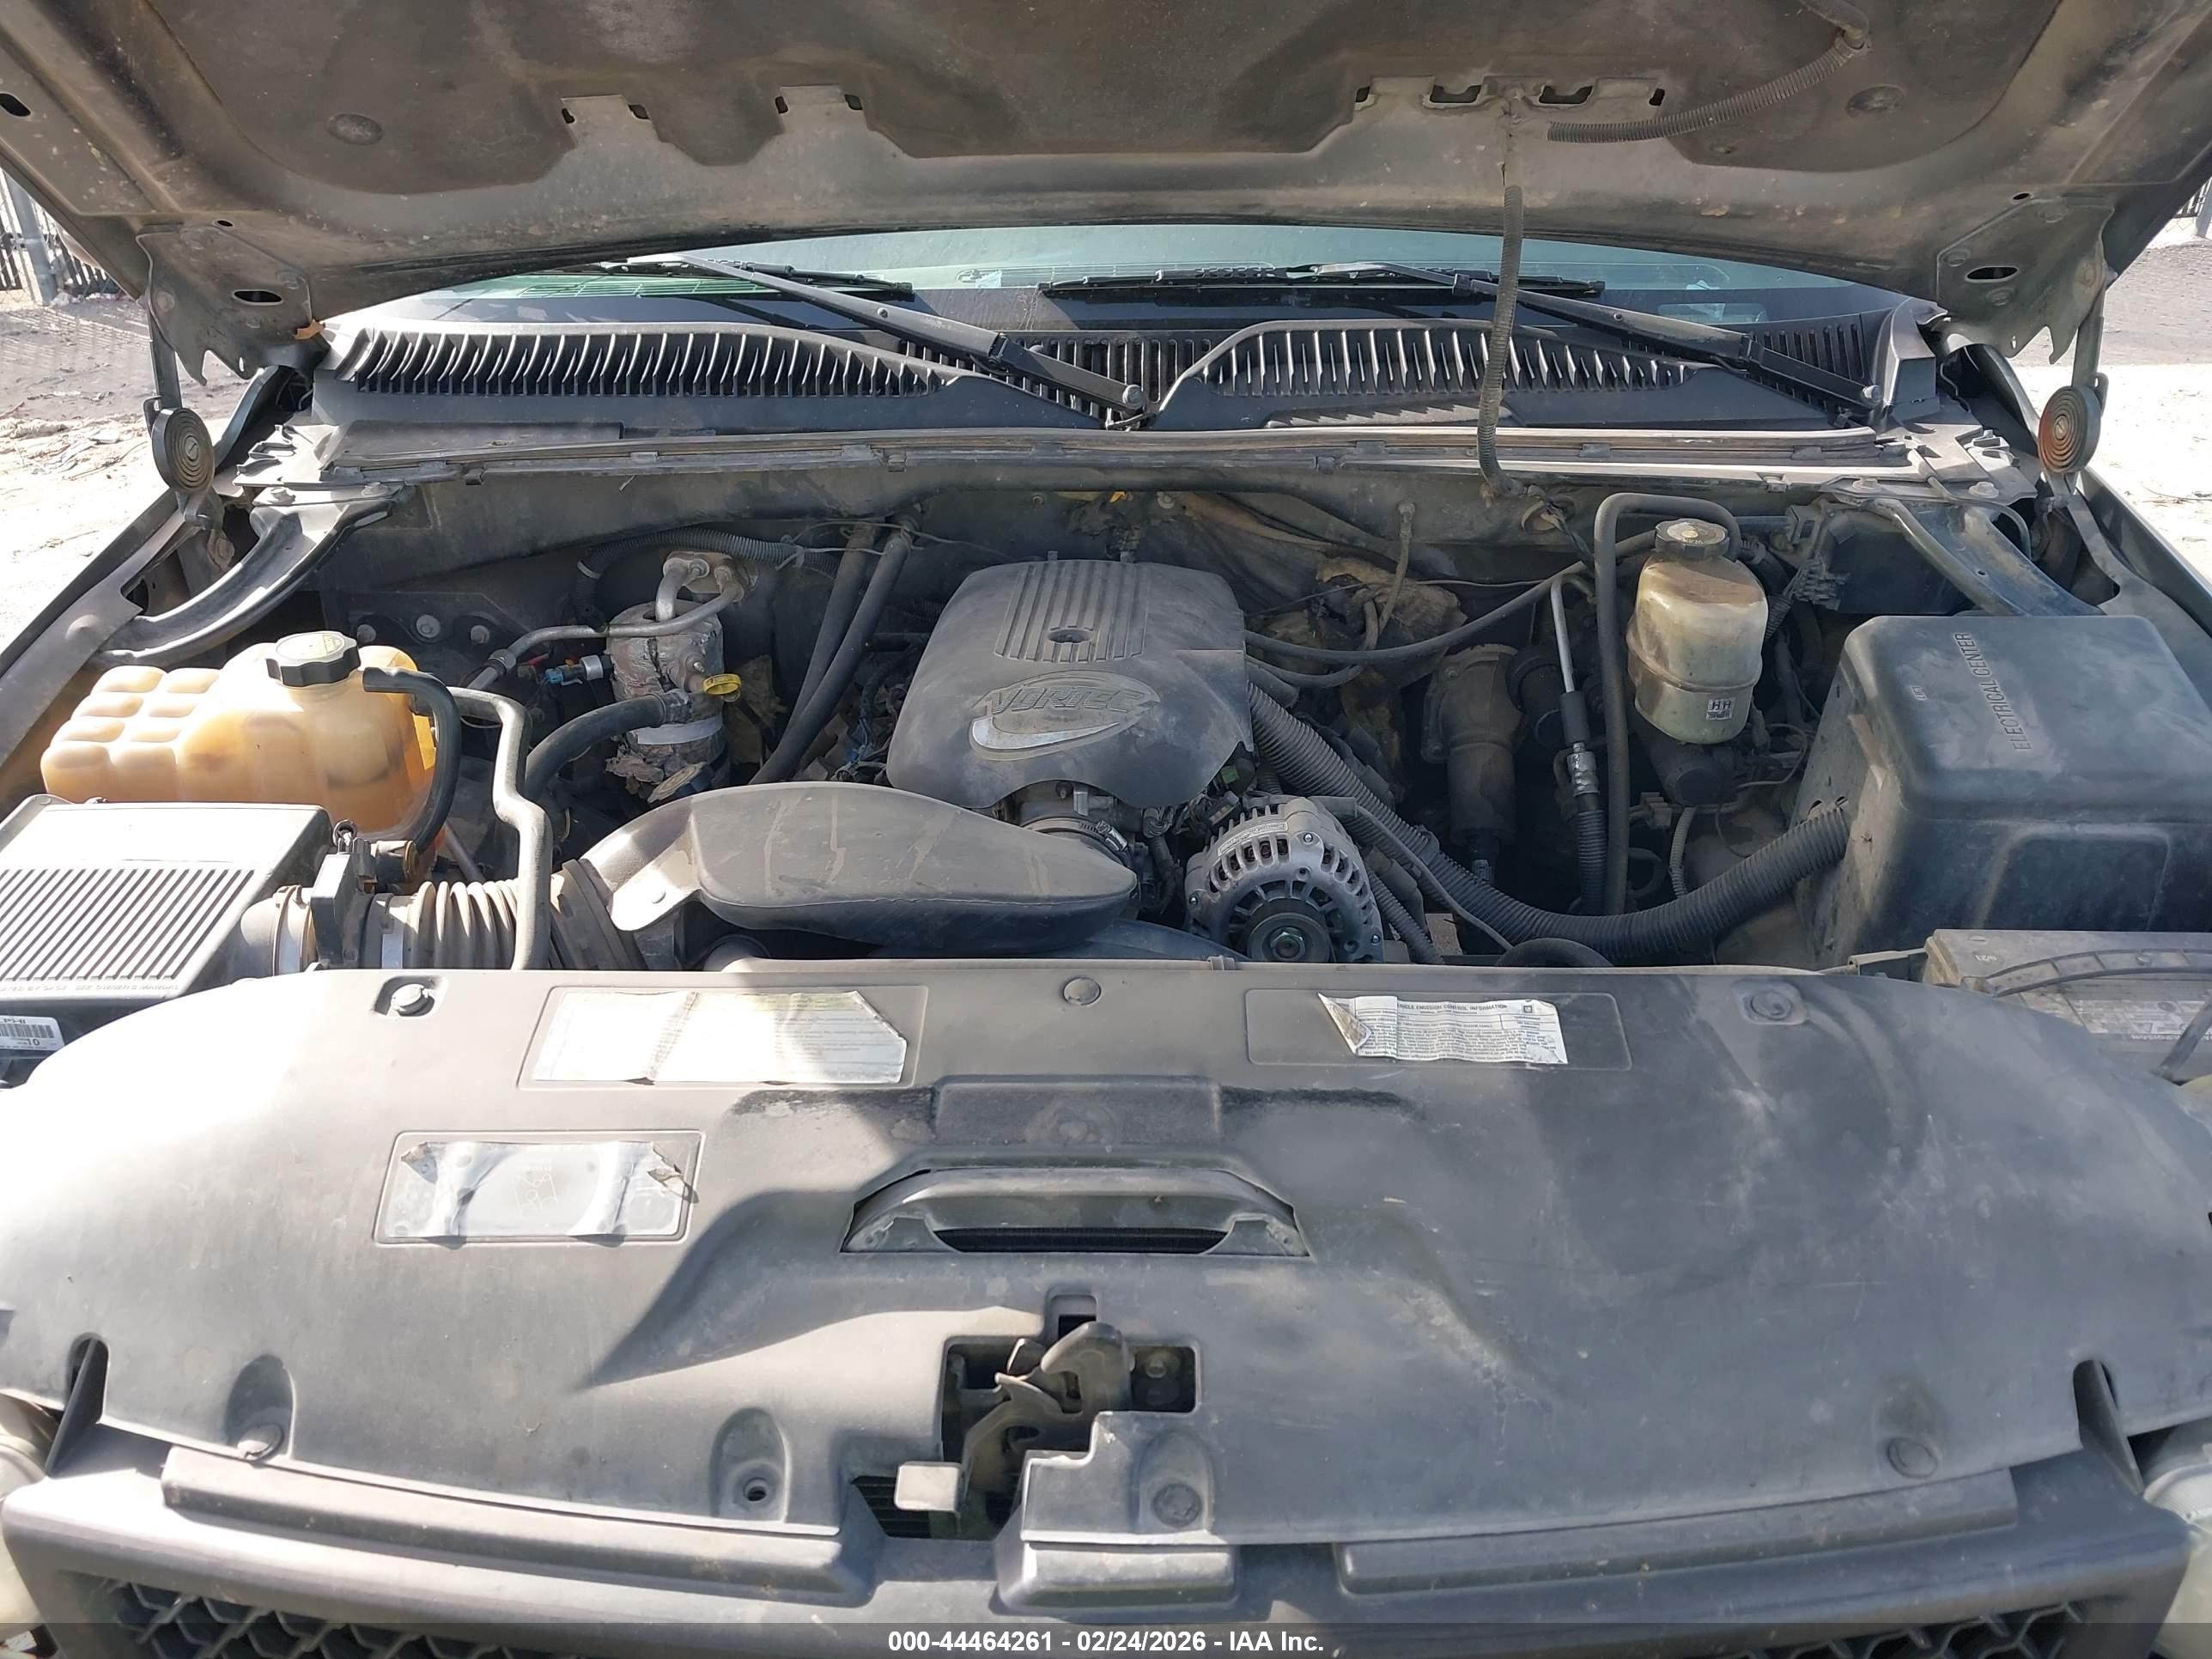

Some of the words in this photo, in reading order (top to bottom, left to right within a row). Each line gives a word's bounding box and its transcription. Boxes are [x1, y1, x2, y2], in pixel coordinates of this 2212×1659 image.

[1954, 632, 1991, 677] CENTER
[991, 685, 1146, 715] VORTEC
[1978, 679, 2033, 750] ELECTRICAL
